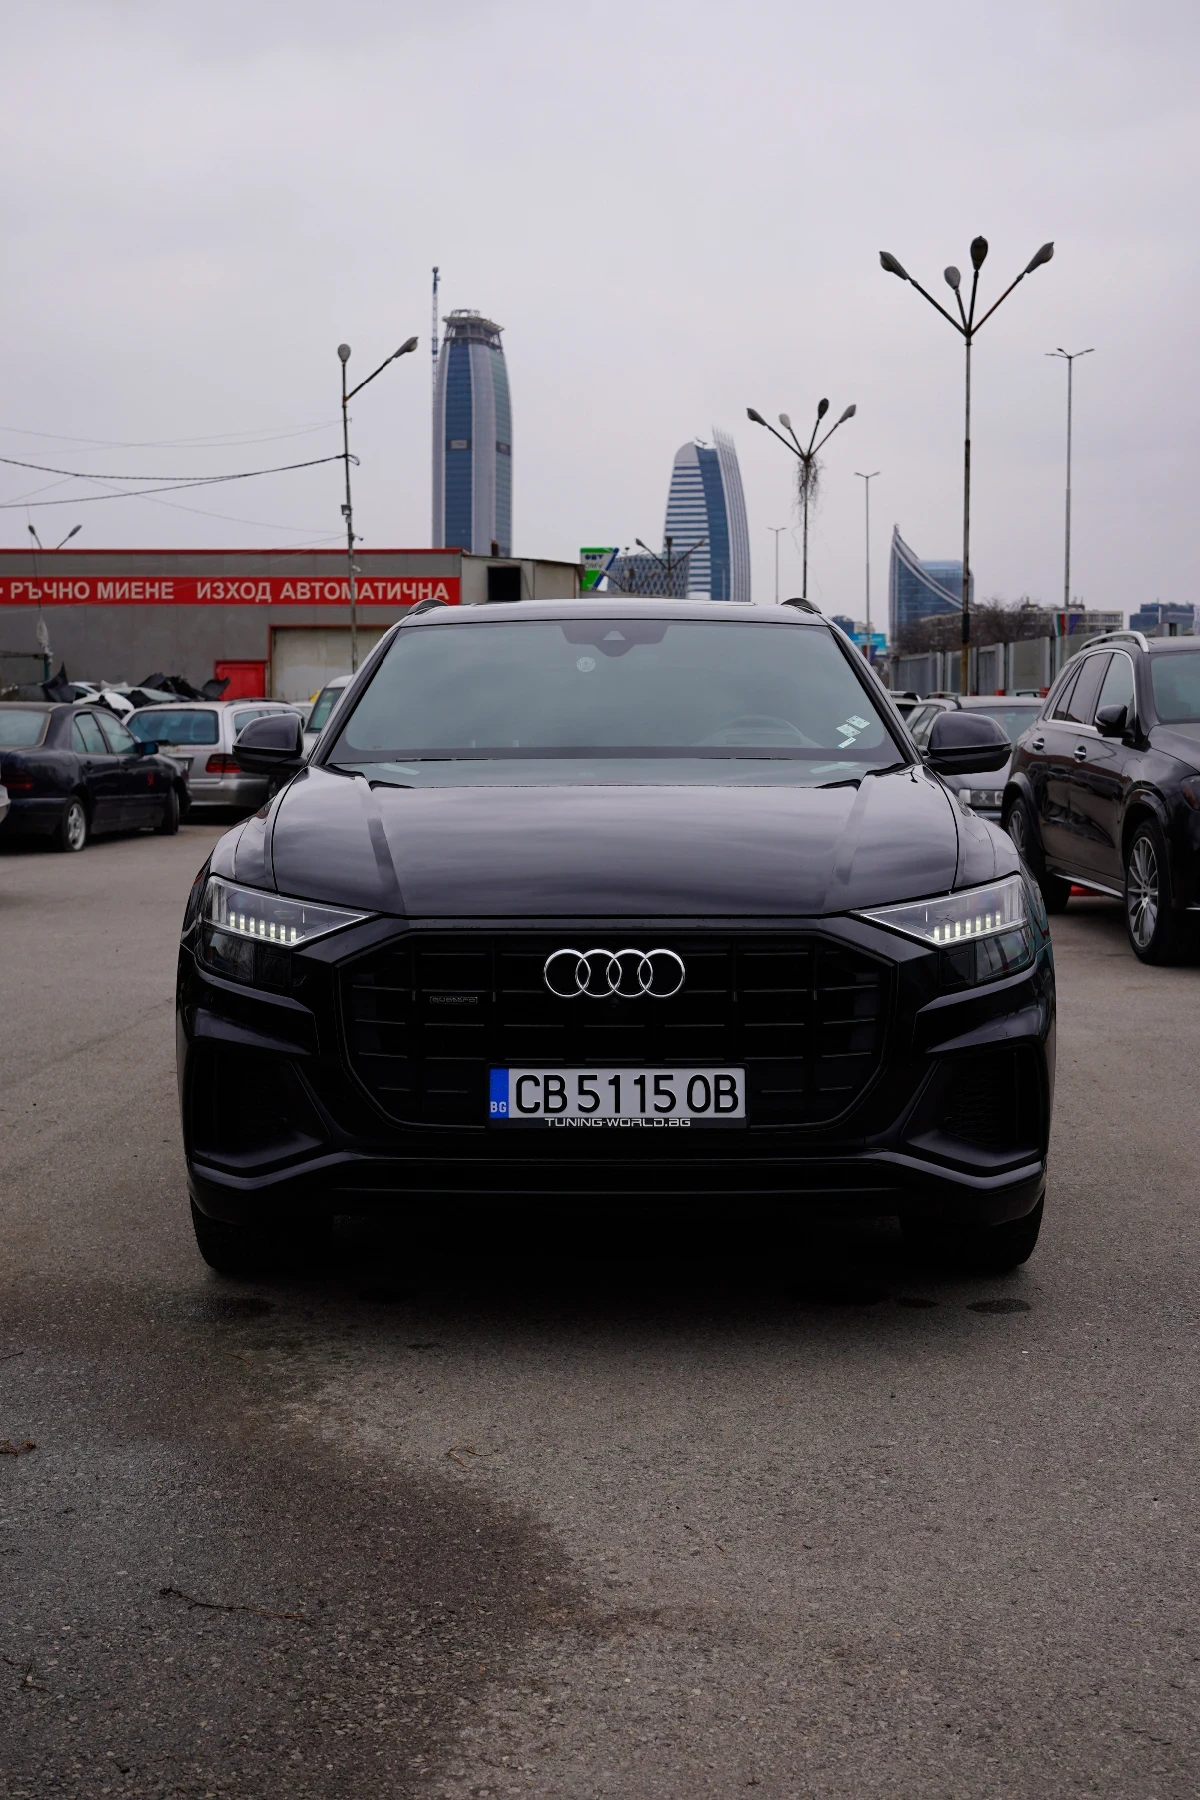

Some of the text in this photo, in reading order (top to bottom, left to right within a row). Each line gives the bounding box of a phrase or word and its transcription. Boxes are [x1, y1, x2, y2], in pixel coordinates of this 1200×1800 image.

[10, 582, 174, 600] РЪЧНО МИЕНЕ
[197, 582, 450, 602] ИЗХОД АВТОМАТИЧНА
[516, 1074, 568, 1114] CB
[577, 1074, 677, 1114] 5115
[490, 1101, 507, 1113] BG
[544, 1118, 691, 1127] TUNING-WORLD.BG
